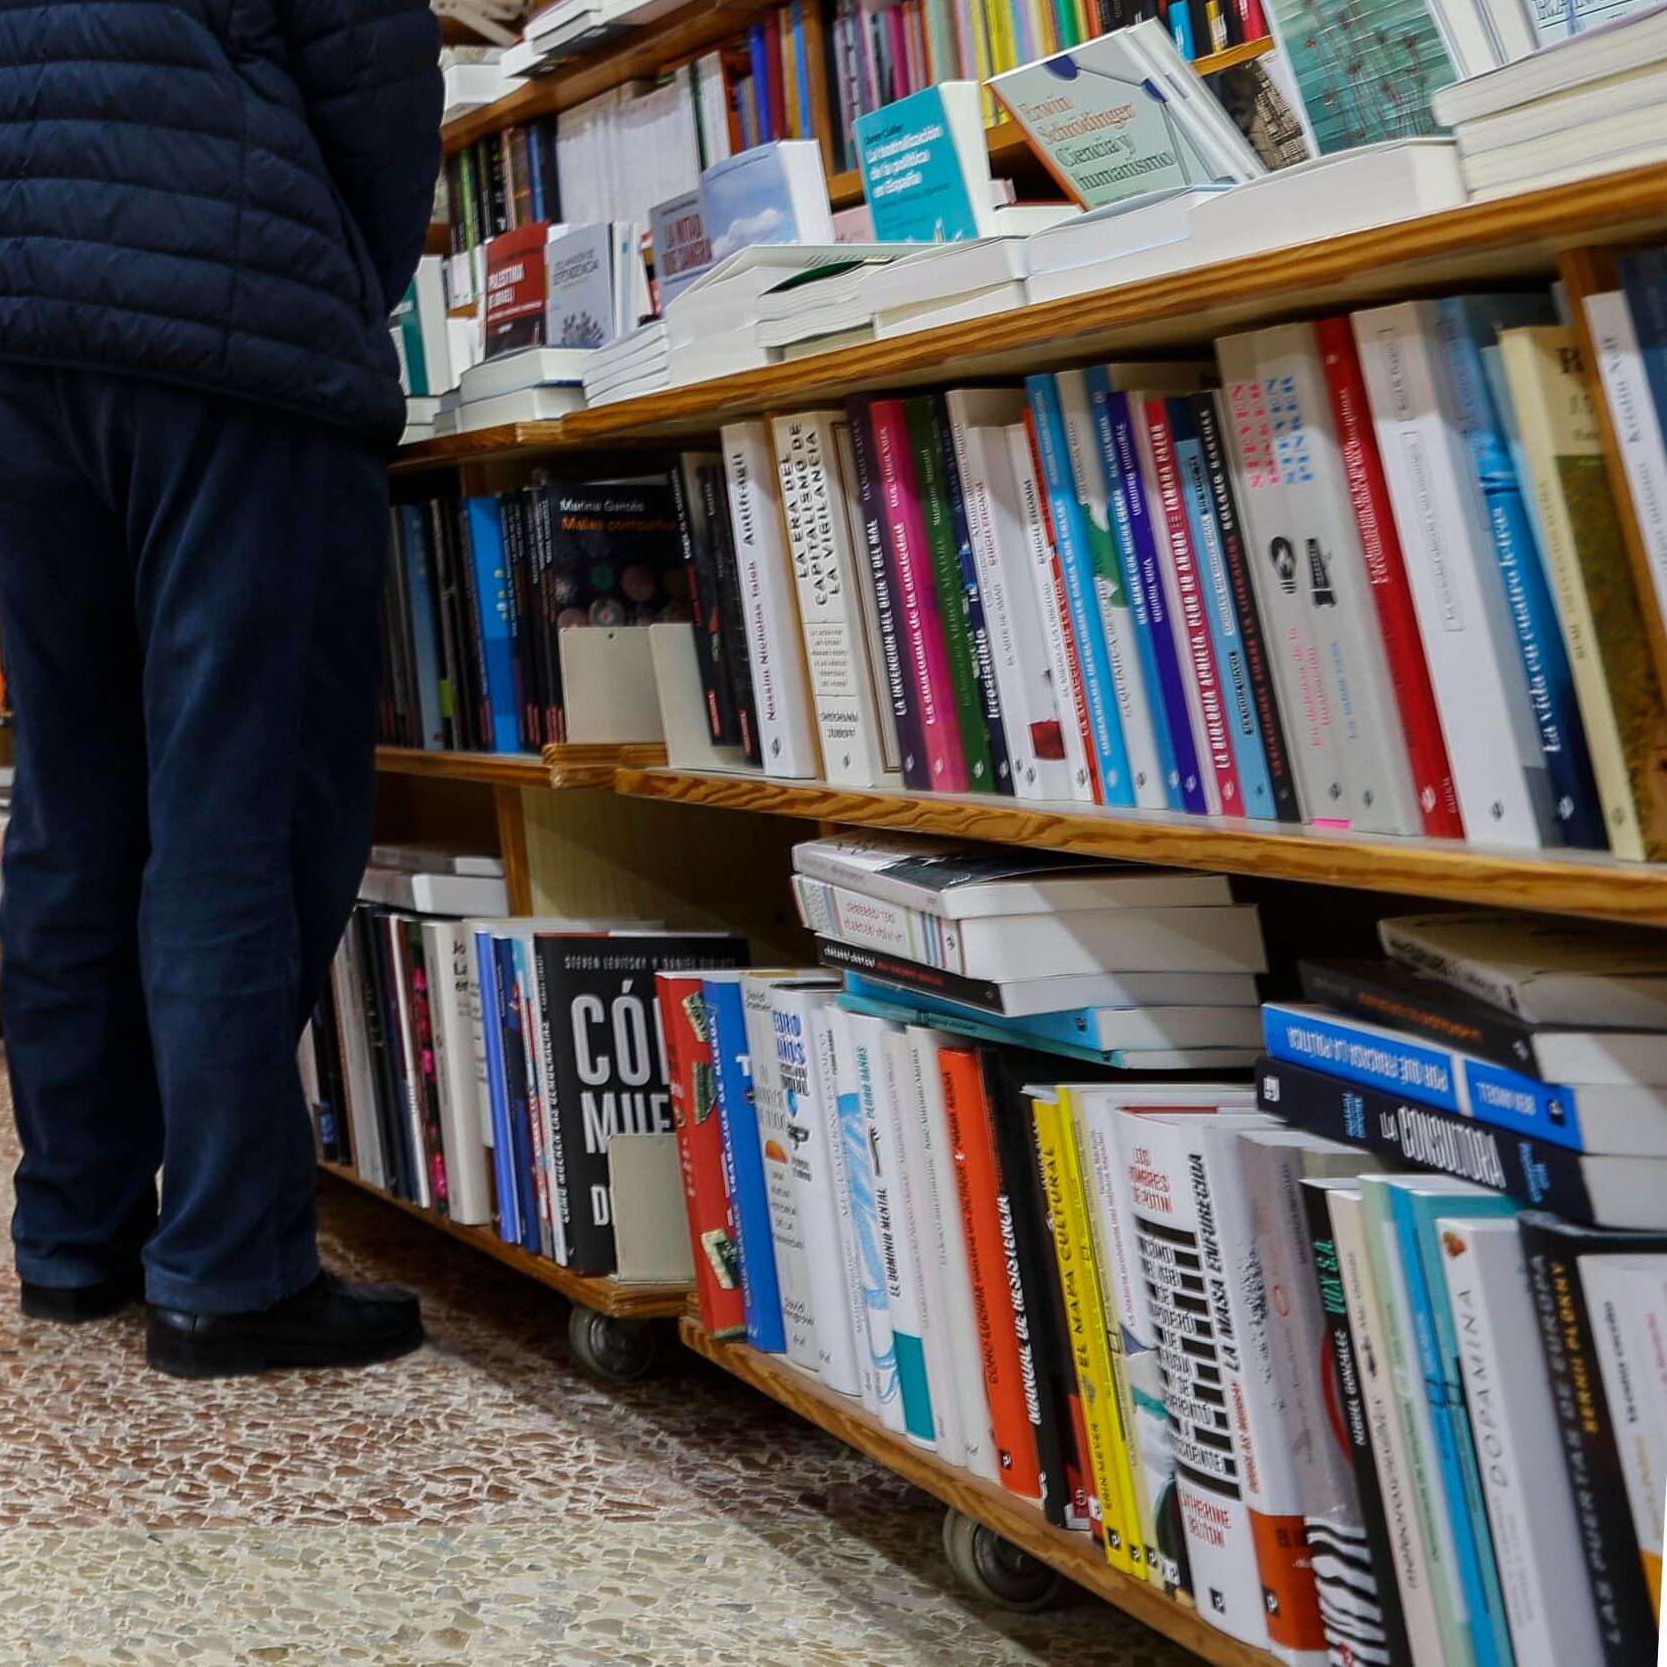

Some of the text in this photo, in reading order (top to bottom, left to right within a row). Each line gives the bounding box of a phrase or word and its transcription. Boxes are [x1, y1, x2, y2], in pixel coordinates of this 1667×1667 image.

[1020, 93, 1075, 122] Erwin
[1054, 132, 1137, 169] Ciencia y
[1071, 149, 1174, 192] humanismo
[560, 497, 603, 513] Marina
[779, 451, 809, 581] LA ERA DEL
[787, 421, 829, 608] CAPITALISMO DE
[805, 430, 842, 597] LA VIGILANCIA
[867, 518, 879, 543] MAL
[871, 545, 884, 565] DEL
[893, 522, 916, 601] ansiedad
[876, 580, 891, 610] BIEN
[747, 560, 777, 722] Nassim Nicholas Taleb
[880, 614, 894, 636] DEL
[1493, 506, 1562, 754] La vida en cuatro letras
[893, 696, 906, 717] LA
[1216, 753, 1230, 771] LA
[563, 954, 649, 971] STEVEN LEVITSKY
[876, 1187, 893, 1230] MENTAL
[882, 1232, 899, 1279] DOMINIO
[1048, 1145, 1091, 1368] EL MAPA CULTURAL
[1187, 1153, 1241, 1371] LA MASA ENFURECIDA
[996, 1194, 1042, 1426] MANUAL DE RESISTENCIA
[1324, 1277, 1347, 1315] VOX
[1529, 1255, 1565, 1379] EUROPA
[1456, 1289, 1509, 1489] DOPAMINA
[1094, 1420, 1108, 1469] MEYER
[1569, 1432, 1607, 1574] PUERTAS
[1593, 1578, 1622, 1646] LAS
